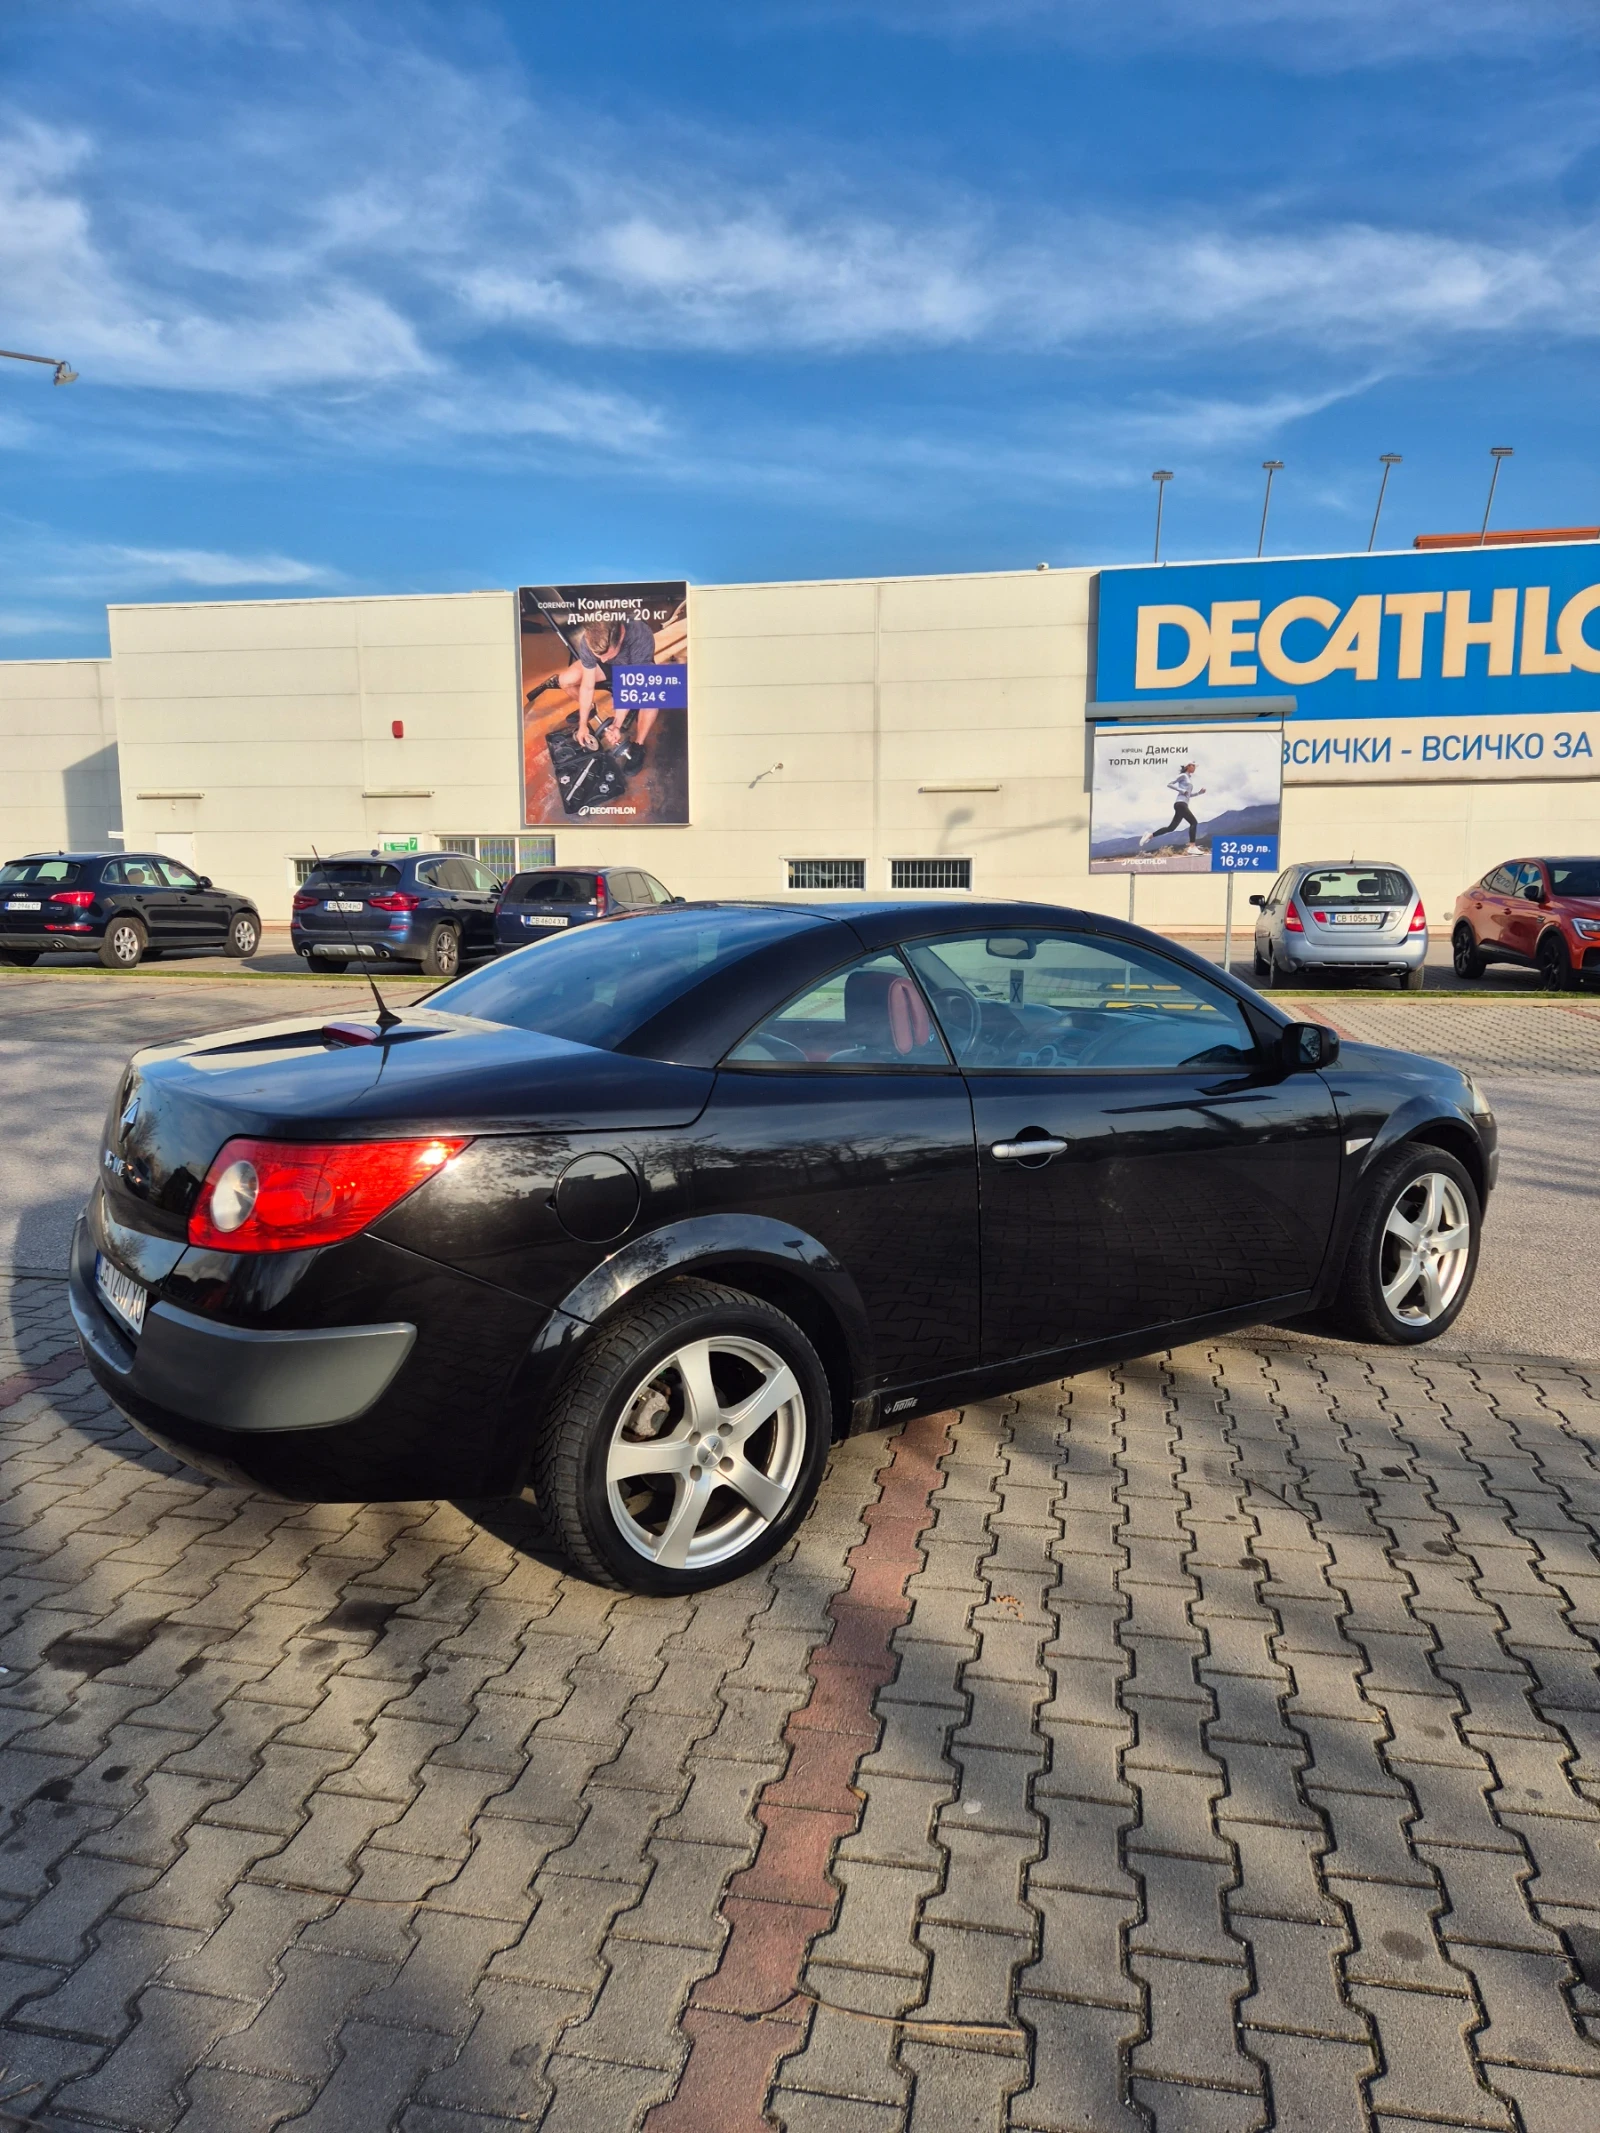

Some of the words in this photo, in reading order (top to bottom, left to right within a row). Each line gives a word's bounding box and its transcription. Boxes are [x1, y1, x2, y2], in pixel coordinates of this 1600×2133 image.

[538, 601, 575, 609] CORENGTH
[577, 598, 643, 610] Комплект
[567, 610, 630, 625] дъмбели,
[633, 609, 650, 621] 20
[653, 610, 667, 620] кг
[620, 673, 663, 687] 109,99
[665, 676, 681, 685] лв.
[620, 689, 656, 704] 56,24
[658, 691, 667, 701] €
[1145, 745, 1189, 756] Дамски
[1421, 732, 1544, 761] ВСИЧКО
[1553, 731, 1593, 759] ЗА
[1108, 758, 1140, 766] топъл
[590, 806, 637, 815] DECATHLON
[410, 839, 417, 848] 7
[1220, 842, 1254, 854] 32,99
[1256, 845, 1271, 853] лв.
[1220, 855, 1250, 868] 16,87
[1252, 857, 1259, 867] €
[540, 917, 557, 925] 4604
[1336, 914, 1347, 923] CB
[1349, 914, 1367, 923] 1056
[1369, 914, 1380, 923] TX
